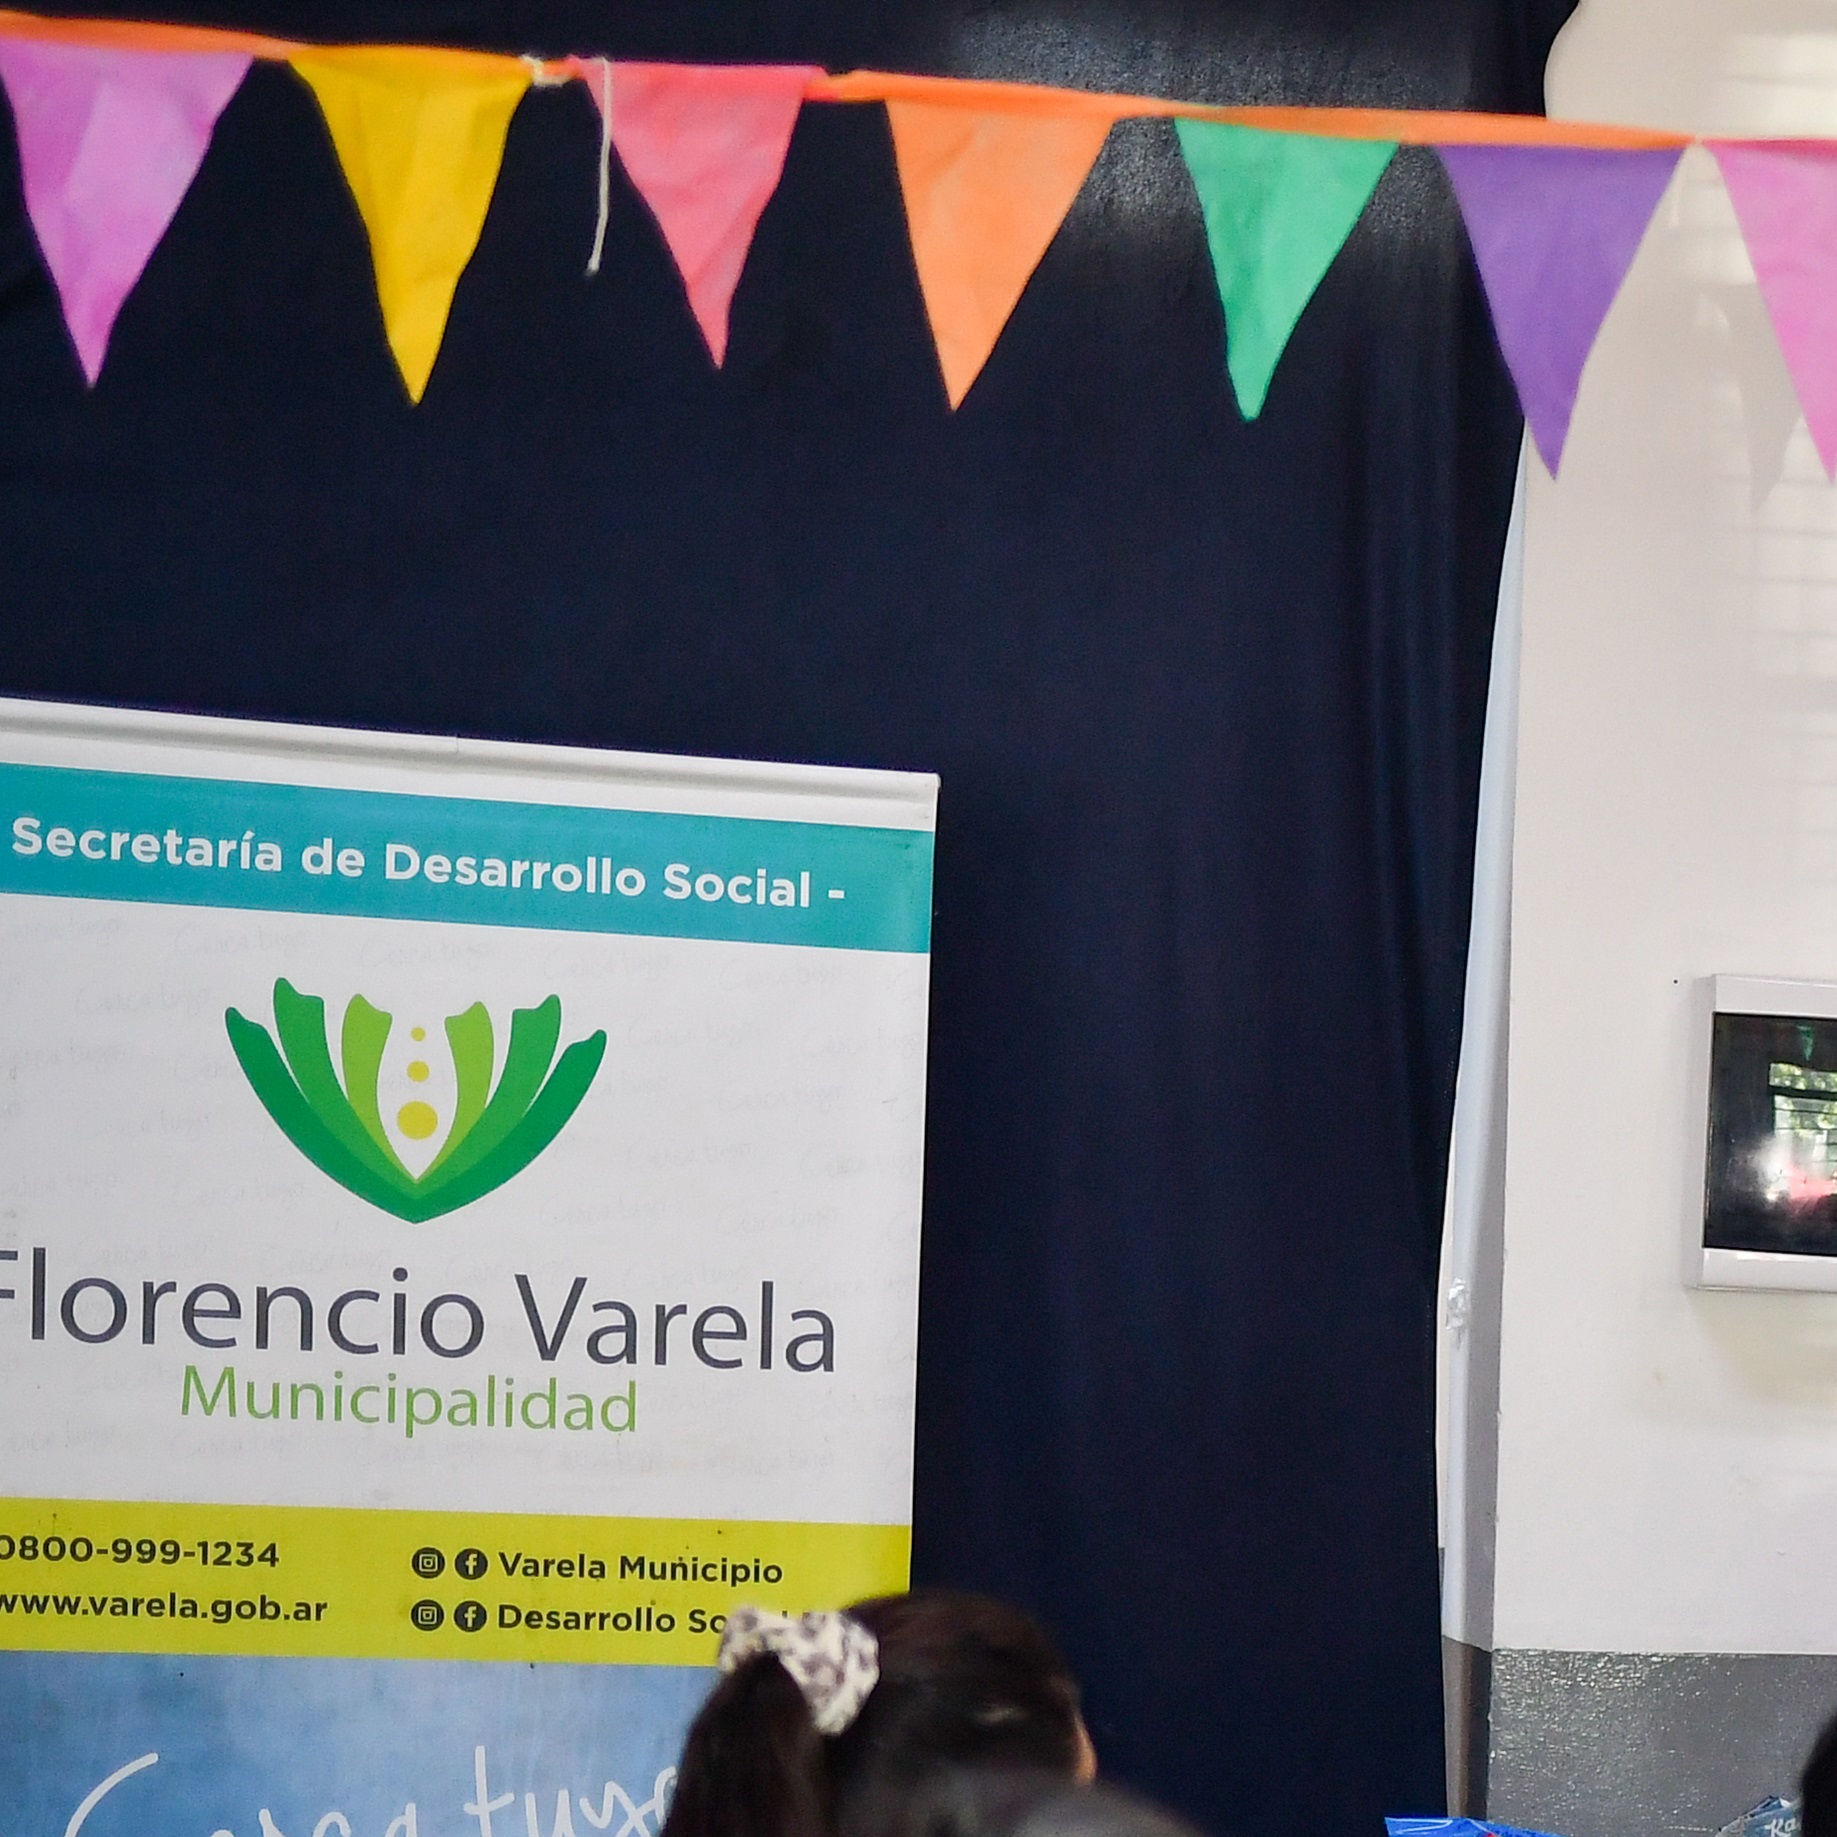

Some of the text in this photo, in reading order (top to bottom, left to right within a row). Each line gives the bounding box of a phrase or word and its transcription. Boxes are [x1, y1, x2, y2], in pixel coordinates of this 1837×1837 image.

[12, 816, 282, 874] Secretaría
[301, 837, 366, 879] de
[385, 845, 647, 898] Desarrollo
[662, 864, 813, 908] Social
[516, 1275, 837, 1373] Varela
[181, 1365, 638, 1437] Municipalidad
[0, 1535, 279, 1568] 0800-999-1234
[499, 1552, 783, 1587] Varela Municipio
[0, 1592, 328, 1624] www.varela.gob.ar
[498, 1604, 676, 1634] Desarrollo
